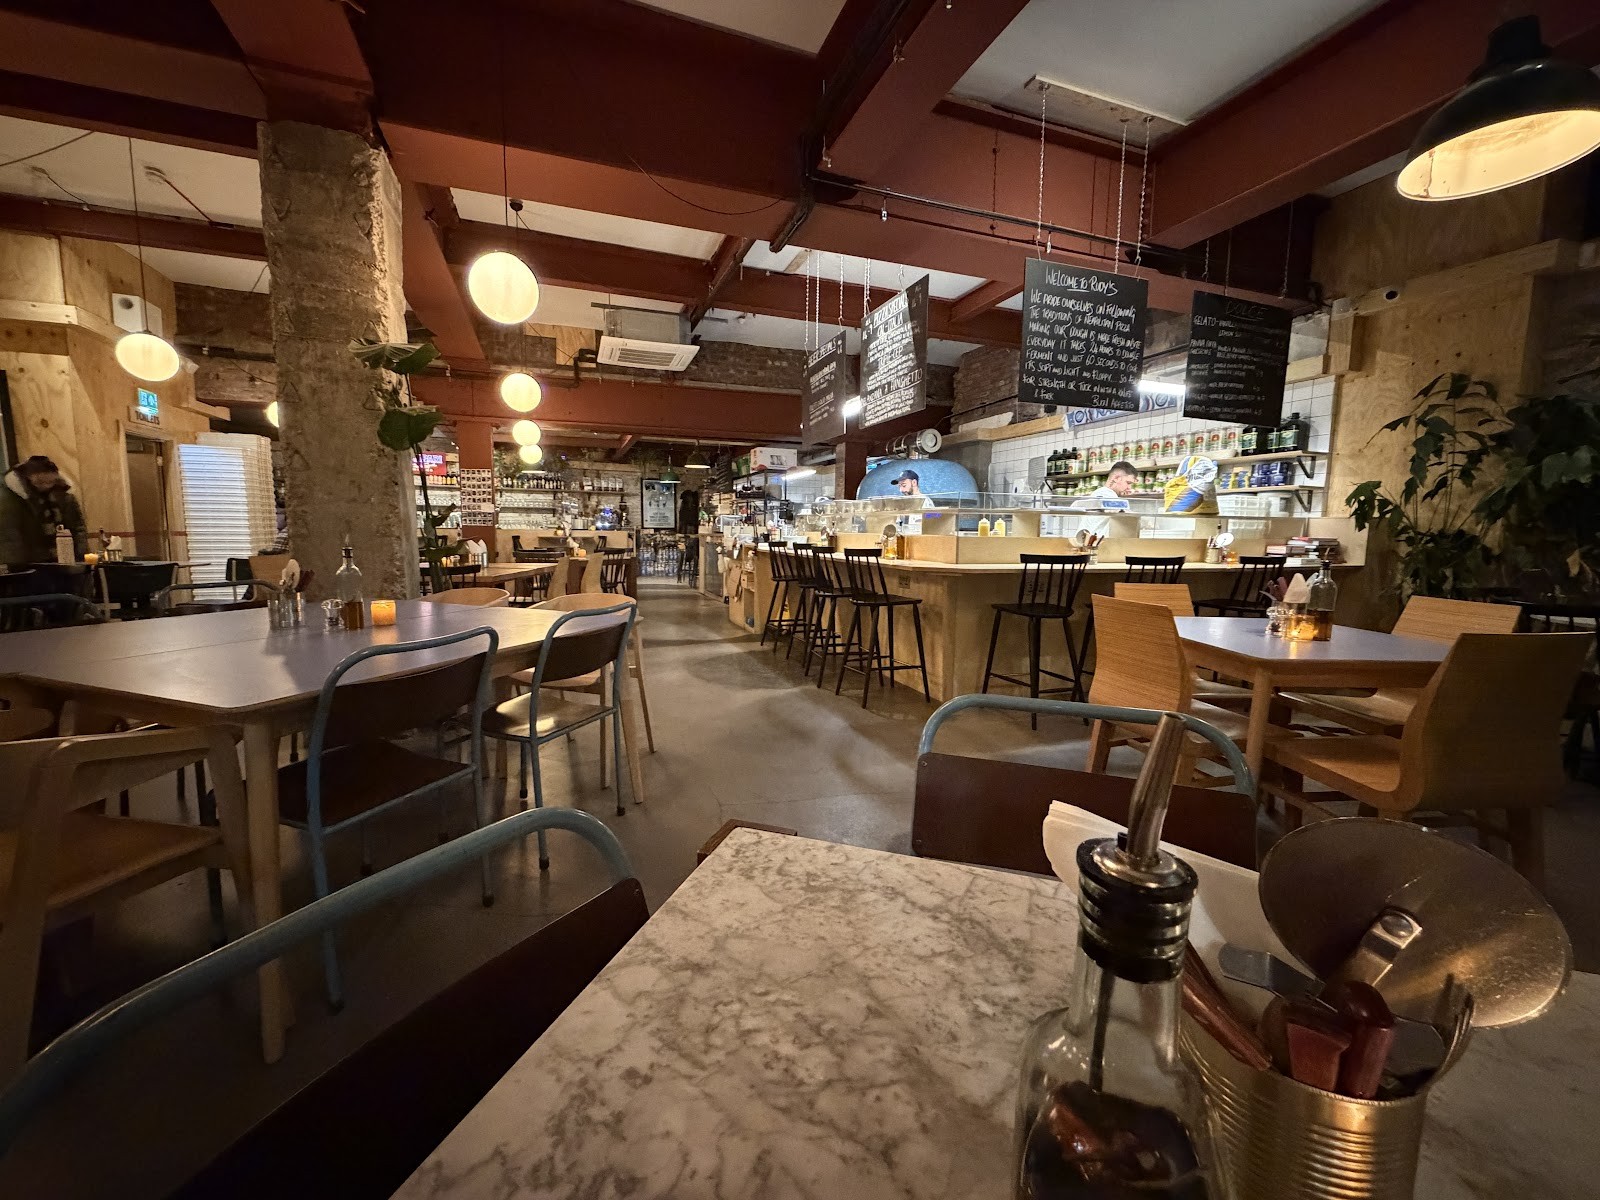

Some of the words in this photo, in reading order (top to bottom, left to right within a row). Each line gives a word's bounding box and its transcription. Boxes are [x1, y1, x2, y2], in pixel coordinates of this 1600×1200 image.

[1045, 265, 1078, 288] WELCOME
[1079, 277, 1088, 289] TO
[1089, 275, 1118, 296] RUDY'S
[1030, 288, 1042, 303] WE
[1043, 293, 1060, 307] PRIDE
[1061, 297, 1094, 315] OURSELVES
[1096, 302, 1105, 315] ON
[1106, 303, 1136, 323] FOLLOWING
[1029, 304, 1040, 319] THE
[1042, 308, 1073, 327] TRADITIONS
[1075, 314, 1082, 324] OF
[1114, 320, 1130, 332] PIZZA
[1029, 320, 1051, 335] MAKING
[1054, 324, 1067, 338] OUR
[1069, 326, 1088, 340] DOUGH
[1090, 330, 1096, 341] IS
[1097, 333, 1111, 345] MADE
[1111, 334, 1125, 346] FRESH
[1026, 335, 1056, 349] EVERYDAY
[1060, 339, 1067, 349] IT
[1070, 340, 1086, 353] TAKES
[1089, 341, 1098, 354] 24
[1098, 344, 1114, 356] HOURS
[1121, 349, 1140, 362] DOUBLE
[1026, 349, 1054, 361] FERMENT
[1057, 354, 1069, 362] AND
[1070, 354, 1084, 363] JUST
[1085, 353, 1095, 366] 60
[1095, 357, 1119, 369] SECONDS
[1119, 361, 1125, 369] TO
[1037, 361, 1054, 374] SOFT
[1052, 367, 1062, 376] AND
[1062, 364, 1081, 377] LIGHT
[1022, 373, 1036, 386] FOR
[1038, 377, 1066, 390] STRENGTH
[1067, 381, 1077, 390] OR
[1078, 382, 1092, 392] TUCK
[1039, 388, 1054, 400] FORK
[1091, 394, 1109, 407] BUON
